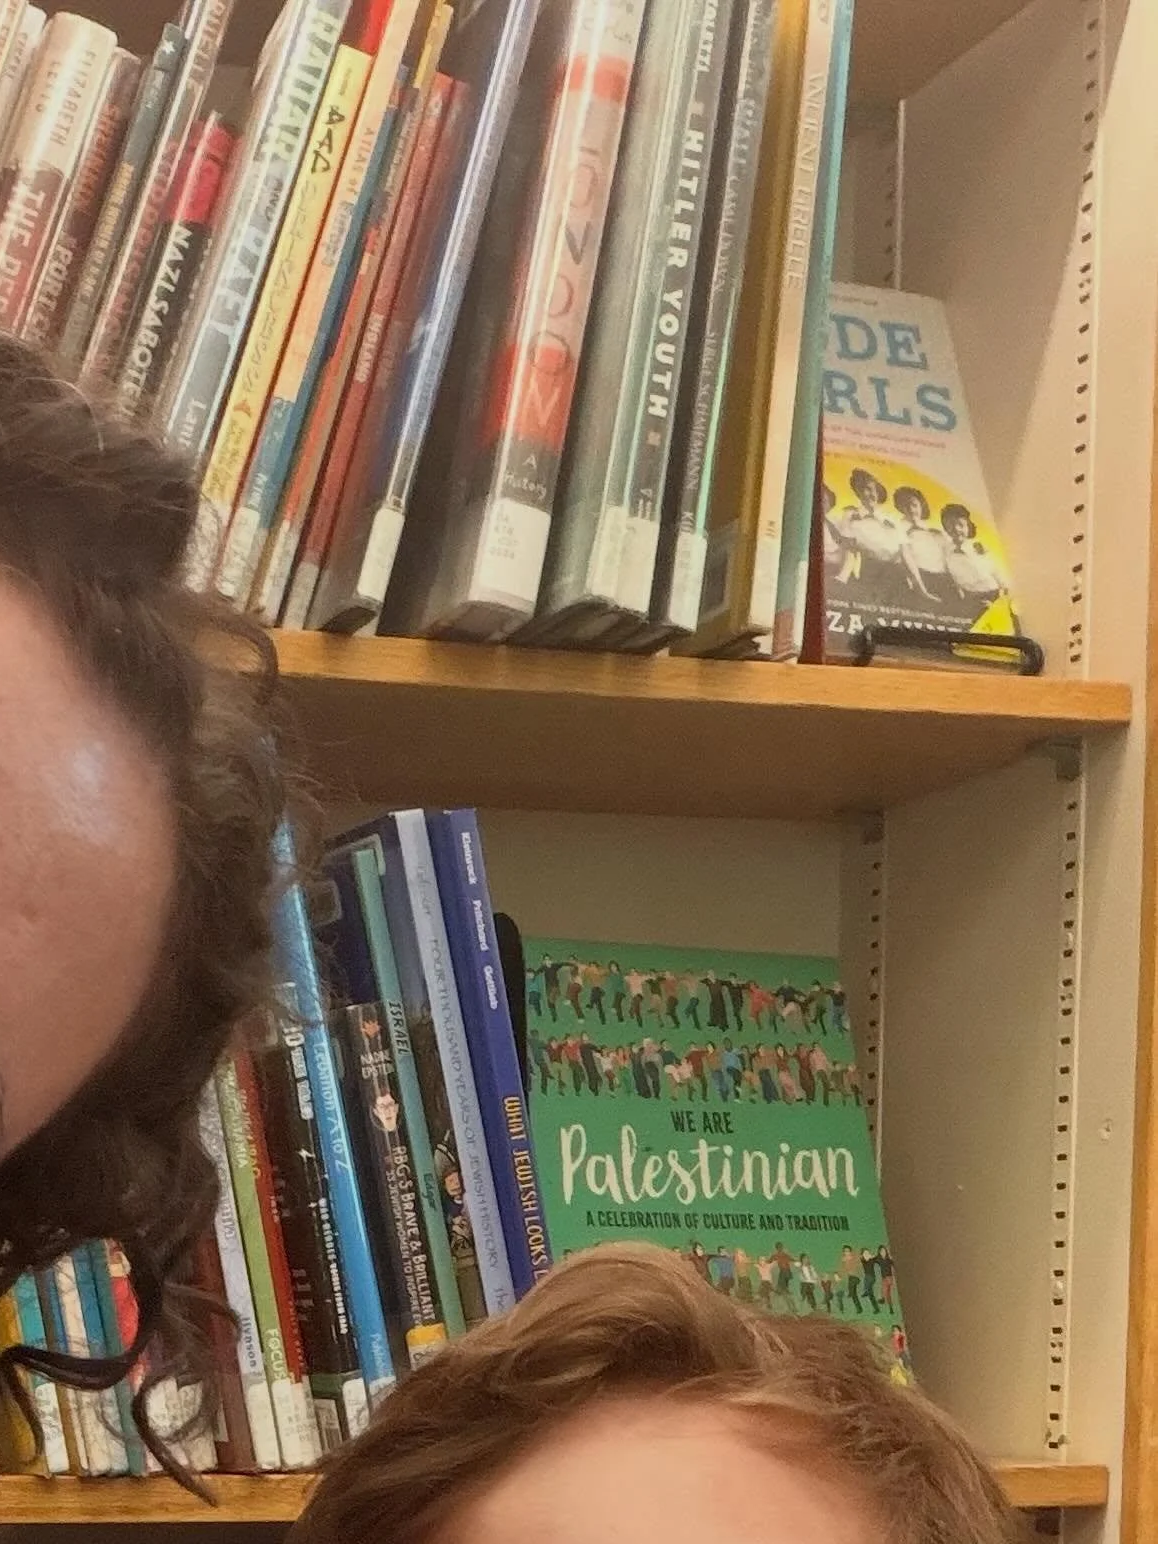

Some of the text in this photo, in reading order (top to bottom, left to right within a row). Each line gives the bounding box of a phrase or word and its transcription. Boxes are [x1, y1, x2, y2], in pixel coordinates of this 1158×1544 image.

[48, 49, 99, 147] ELIZABETH
[667, 128, 704, 269] HITLER
[647, 287, 683, 420] YOUTH
[427, 937, 447, 983] FOUR
[471, 899, 492, 953] Pritchard
[482, 965, 501, 1010] Gottlieb
[389, 999, 410, 1056] ISRAEL
[435, 984, 464, 1074] THOUSAND
[503, 1095, 528, 1142] WHAT
[670, 1110, 733, 1134] WE ARE
[465, 1150, 488, 1204] JEWISH
[511, 1147, 538, 1213] JEWISH
[559, 1123, 860, 1205] Palestinian
[387, 1181, 400, 1216] JEWISH
[400, 1192, 420, 1236] BRAVE
[586, 1210, 849, 1233] A CELEBRATION OF CULTURE AND TRADITION
[392, 1218, 405, 1256] WOMEN
[400, 1256, 409, 1268] TO
[407, 1237, 420, 1254] &
[475, 1202, 500, 1273] HISTORY
[524, 1214, 550, 1266] LOOKS
[412, 1254, 436, 1321] BRILLIANT
[336, 1313, 348, 1336] IRAQ
[266, 1327, 288, 1384] FOCUS
